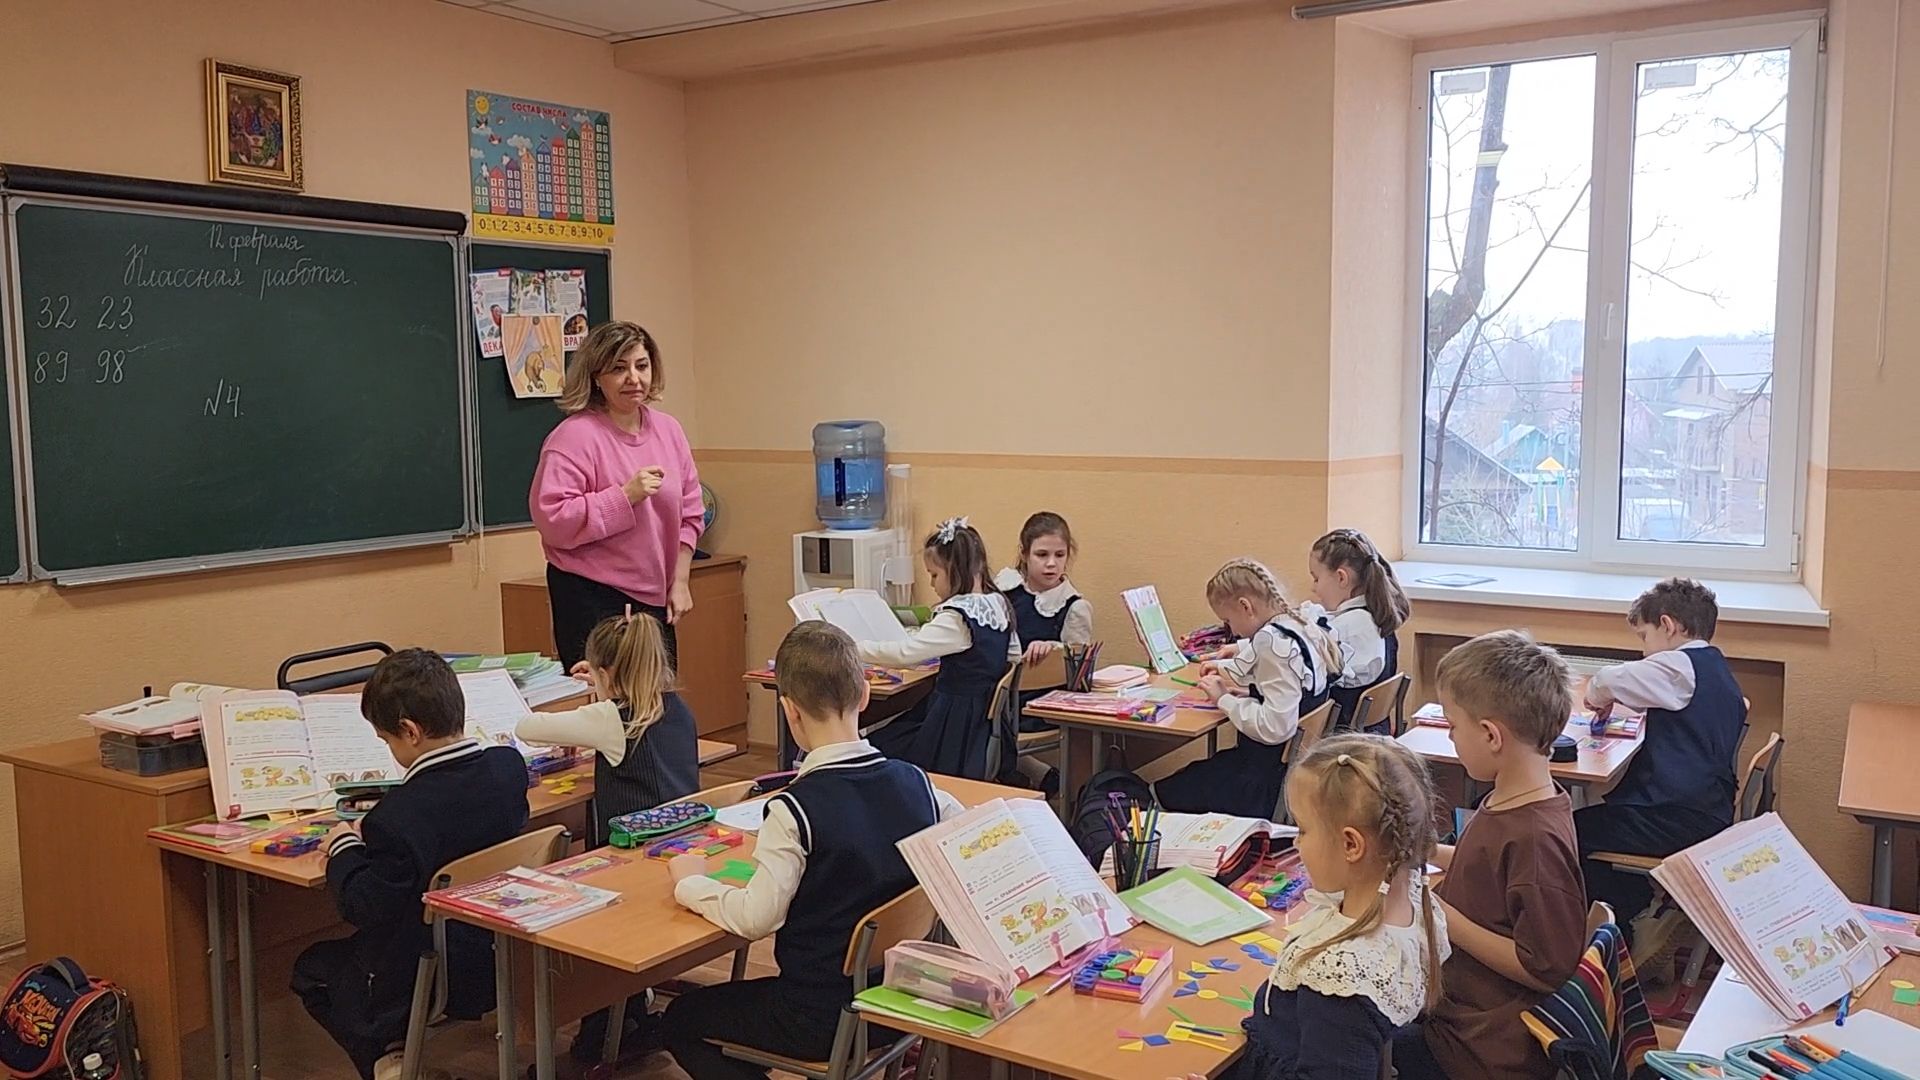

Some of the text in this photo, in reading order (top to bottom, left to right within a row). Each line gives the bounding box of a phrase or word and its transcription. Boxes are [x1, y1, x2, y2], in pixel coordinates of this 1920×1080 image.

[511, 102, 541, 114] СОСТАВ
[207, 223, 305, 265] 12 февраля
[480, 218, 603, 238] 0 1 2 3 4 5 6 7 8 9 10
[123, 243, 245, 289] Классная
[37, 295, 134, 330] 32 23
[34, 349, 126, 384] 89 98
